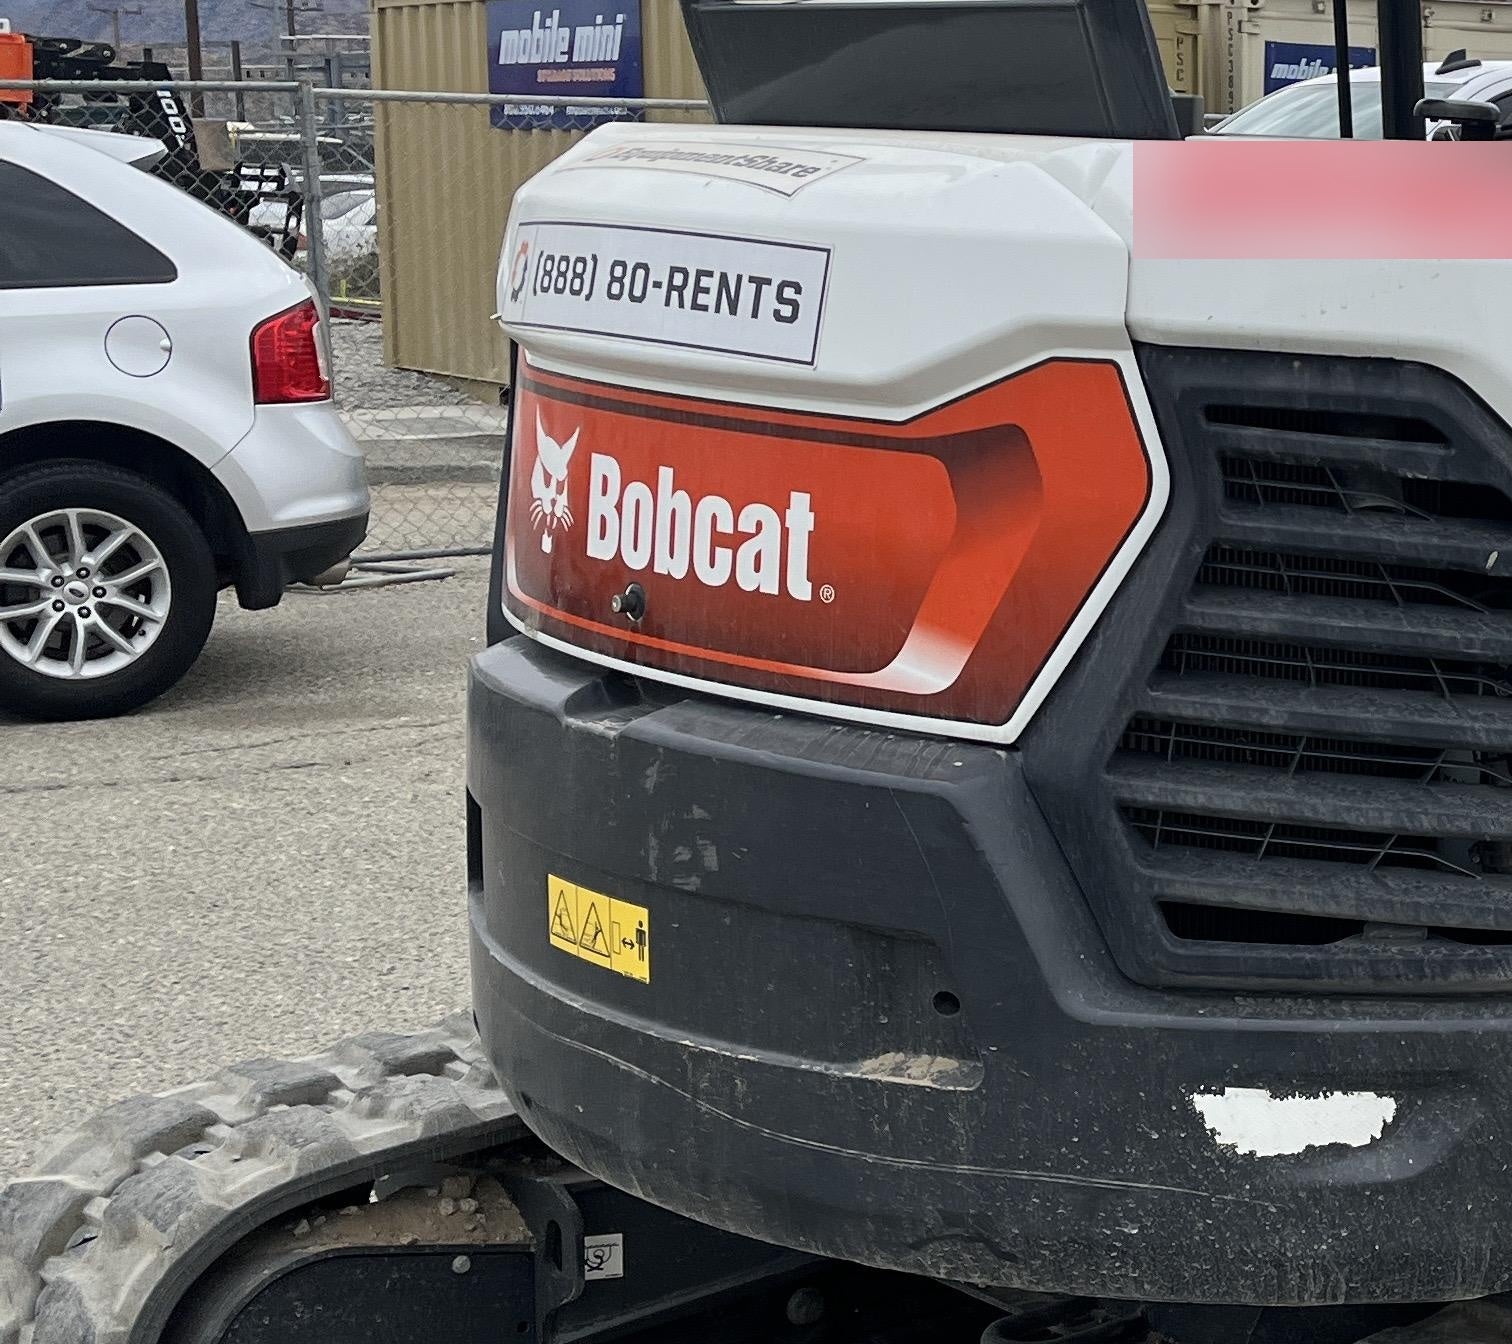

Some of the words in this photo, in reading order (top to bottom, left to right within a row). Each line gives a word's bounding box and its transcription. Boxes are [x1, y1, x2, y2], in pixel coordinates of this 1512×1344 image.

[499, 9, 570, 65] mobile
[572, 13, 624, 62] mini
[532, 249, 599, 302] (888)
[606, 259, 803, 325] 80-RENTS
[586, 452, 815, 601] Bobcat
